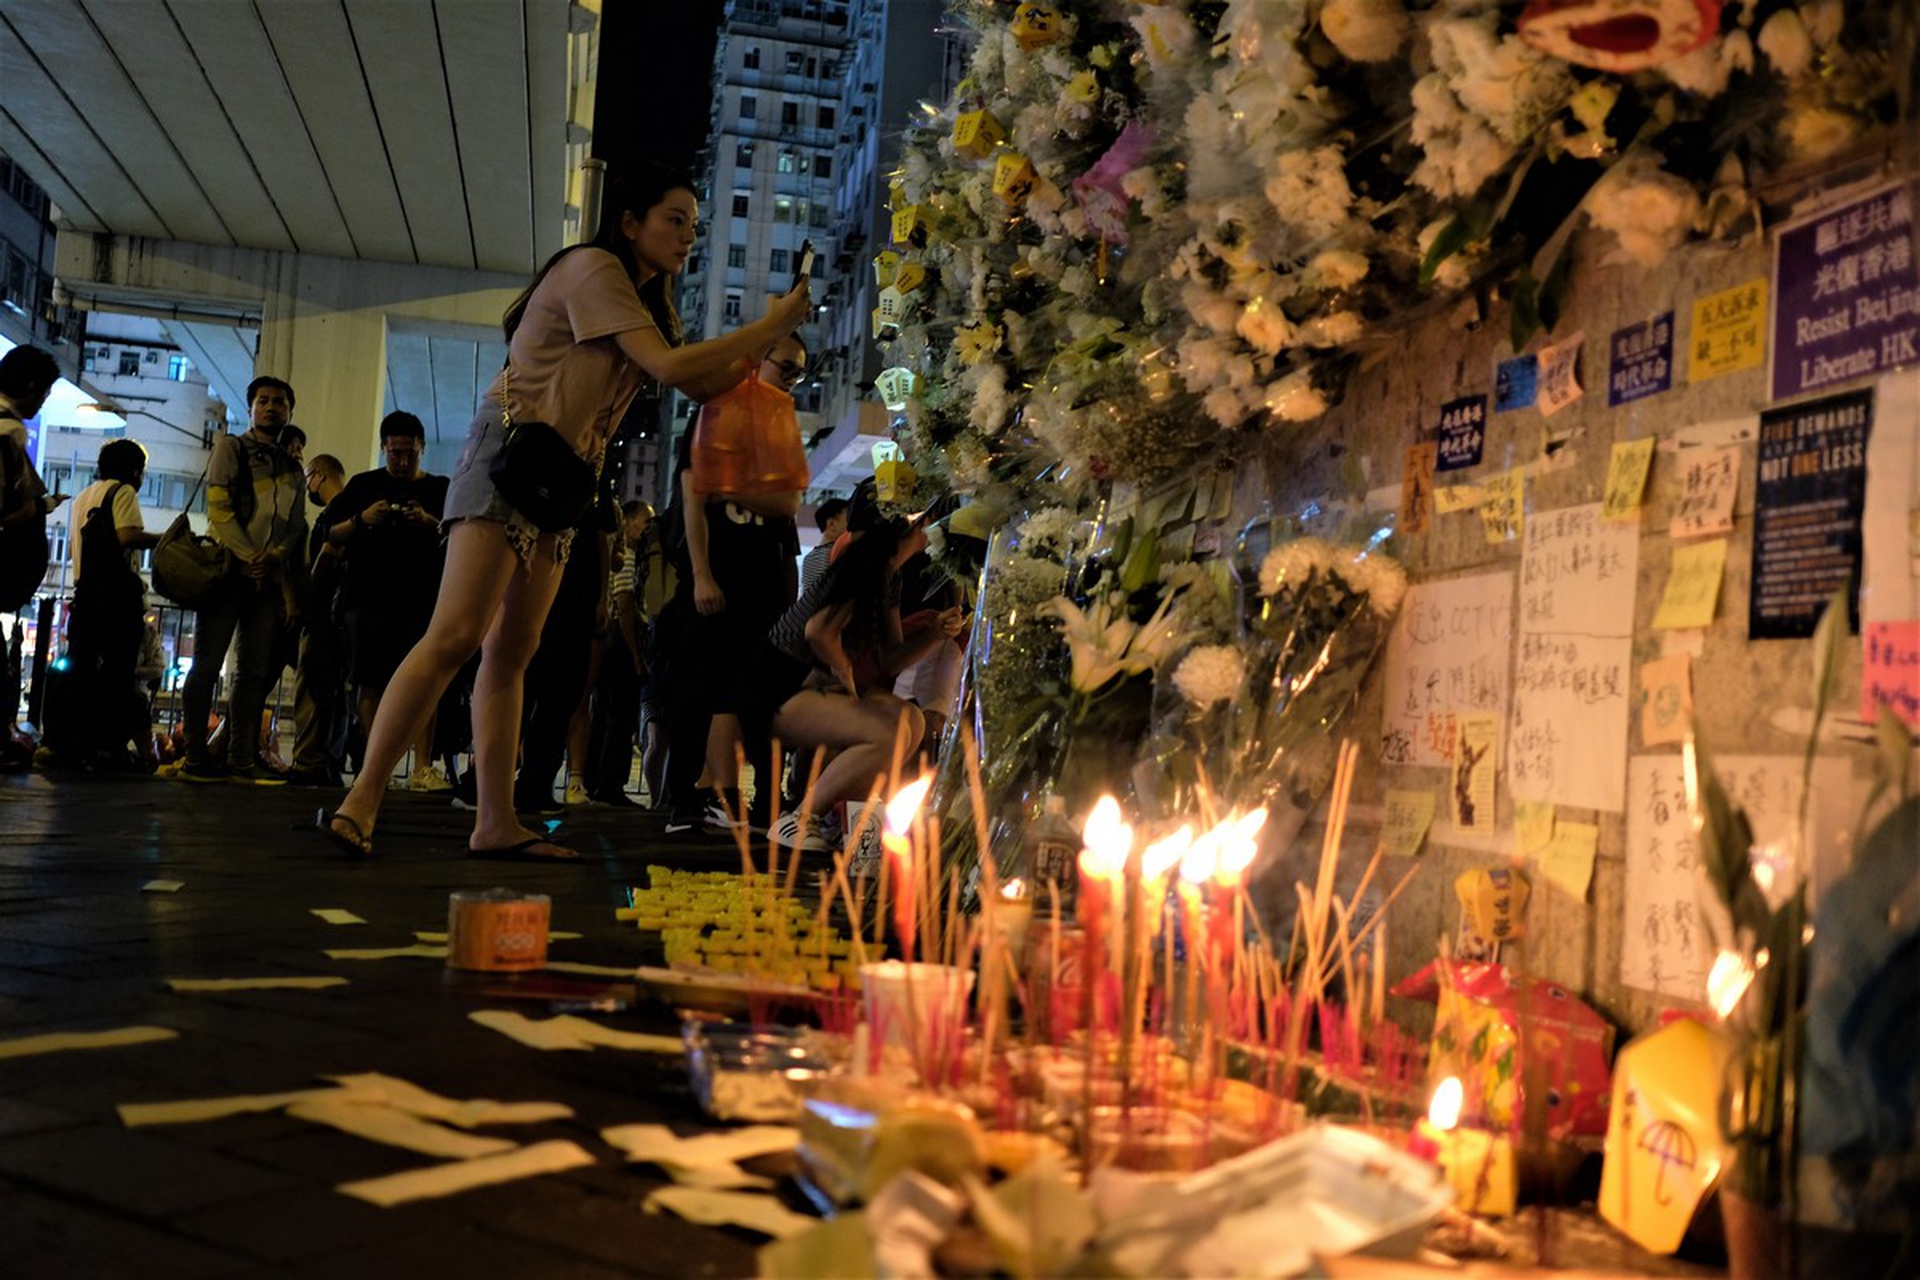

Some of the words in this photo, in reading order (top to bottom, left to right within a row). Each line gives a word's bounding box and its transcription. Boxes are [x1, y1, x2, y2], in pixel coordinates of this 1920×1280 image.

[1795, 307, 1851, 346] Resist
[1801, 347, 1877, 389] Liberate
[1881, 327, 1917, 366] HK
[1797, 404, 1866, 437] DEMANDS
[1761, 456, 1789, 483] NOT
[1822, 441, 1864, 472] LESS
